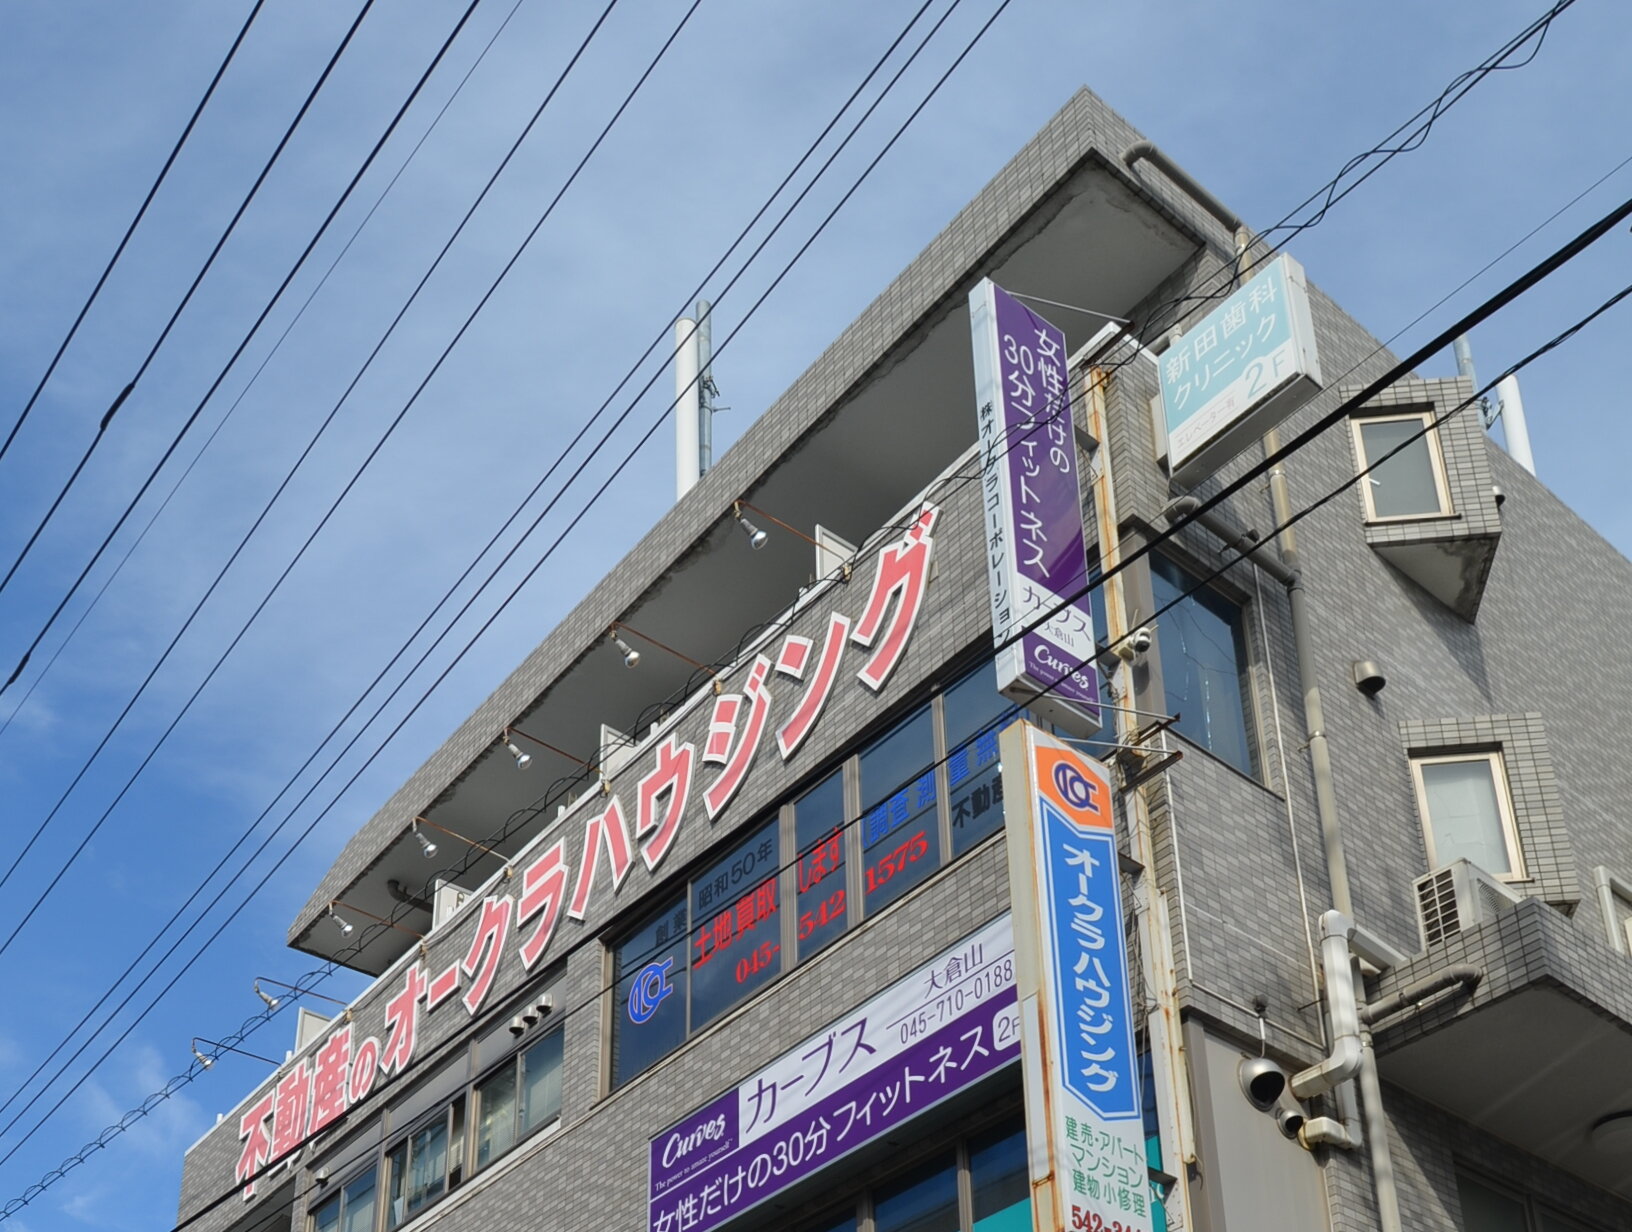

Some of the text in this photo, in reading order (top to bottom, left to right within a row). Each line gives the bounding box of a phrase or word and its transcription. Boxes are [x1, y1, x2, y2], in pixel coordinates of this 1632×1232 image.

[1166, 276, 1277, 385] 新田歯科
[1174, 314, 1278, 410] クリニック
[1245, 349, 1286, 400] 2F
[1033, 328, 1069, 474] 女性だけの
[1004, 334, 1051, 578] 30分フィットネス
[1032, 644, 1089, 689] Curves
[798, 889, 846, 940] 542
[864, 831, 928, 896] 1575
[900, 959, 1014, 1045] 045-710-0188
[924, 943, 984, 999] 大倉山
[1061, 843, 1119, 1094] オークラハウジング
[745, 1017, 877, 1135] カーブス
[662, 1113, 726, 1168] Curves
[1064, 1115, 1145, 1165] 建売・アパート
[1070, 1143, 1144, 1188] マンション
